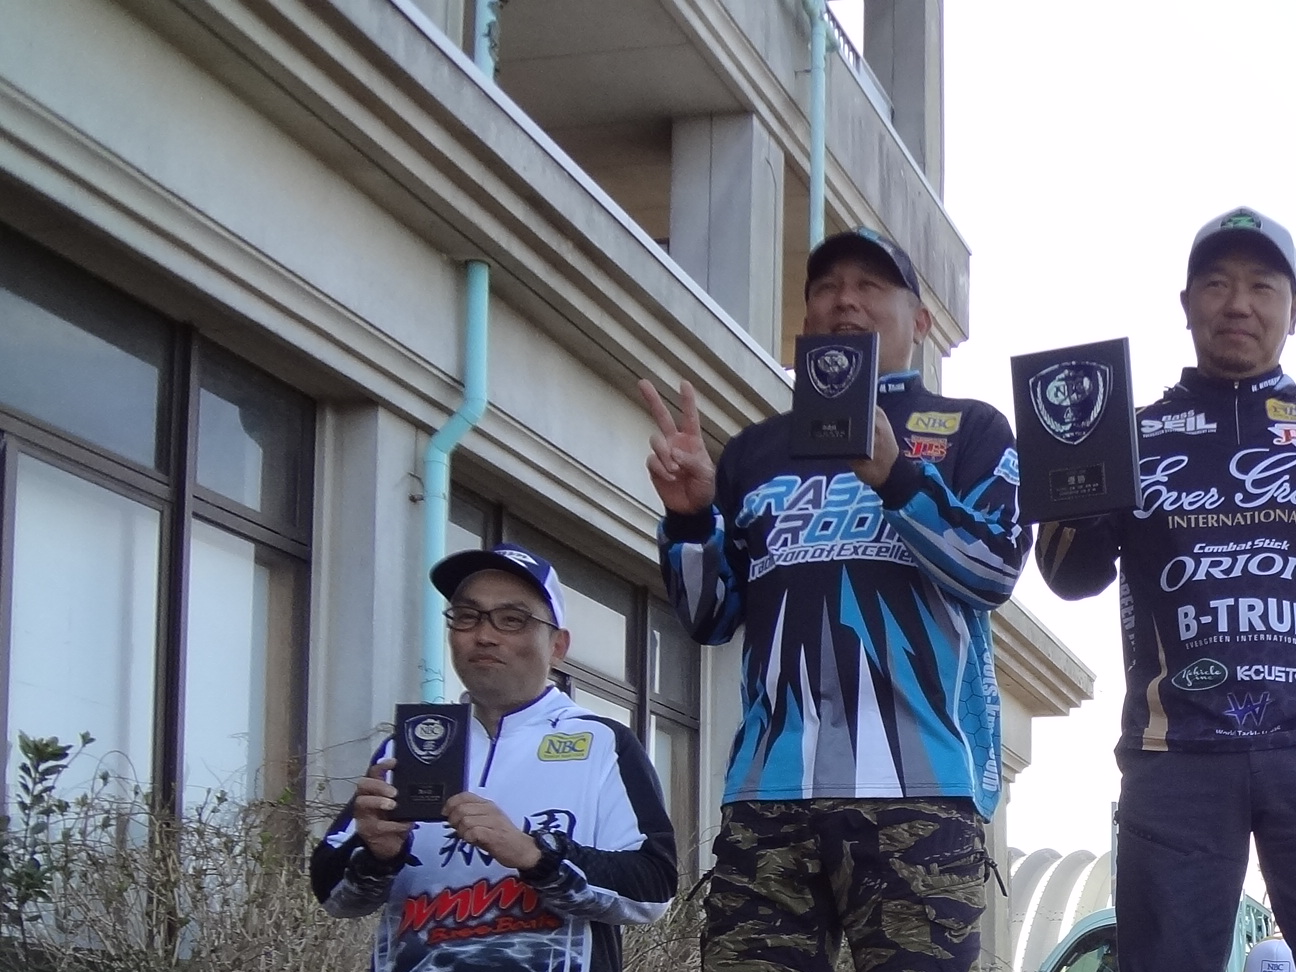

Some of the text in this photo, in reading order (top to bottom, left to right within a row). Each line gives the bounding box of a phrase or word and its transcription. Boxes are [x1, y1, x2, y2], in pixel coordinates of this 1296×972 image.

[915, 416, 956, 429] NBC
[1133, 455, 1225, 518] Ever
[836, 542, 914, 564] Excelle
[1193, 538, 1290, 554] Combat Stick
[1185, 636, 1231, 650] EVERGREEN
[419, 726, 439, 736] NBC
[545, 738, 587, 755] NBC
[1267, 963, 1284, 971] NBC
